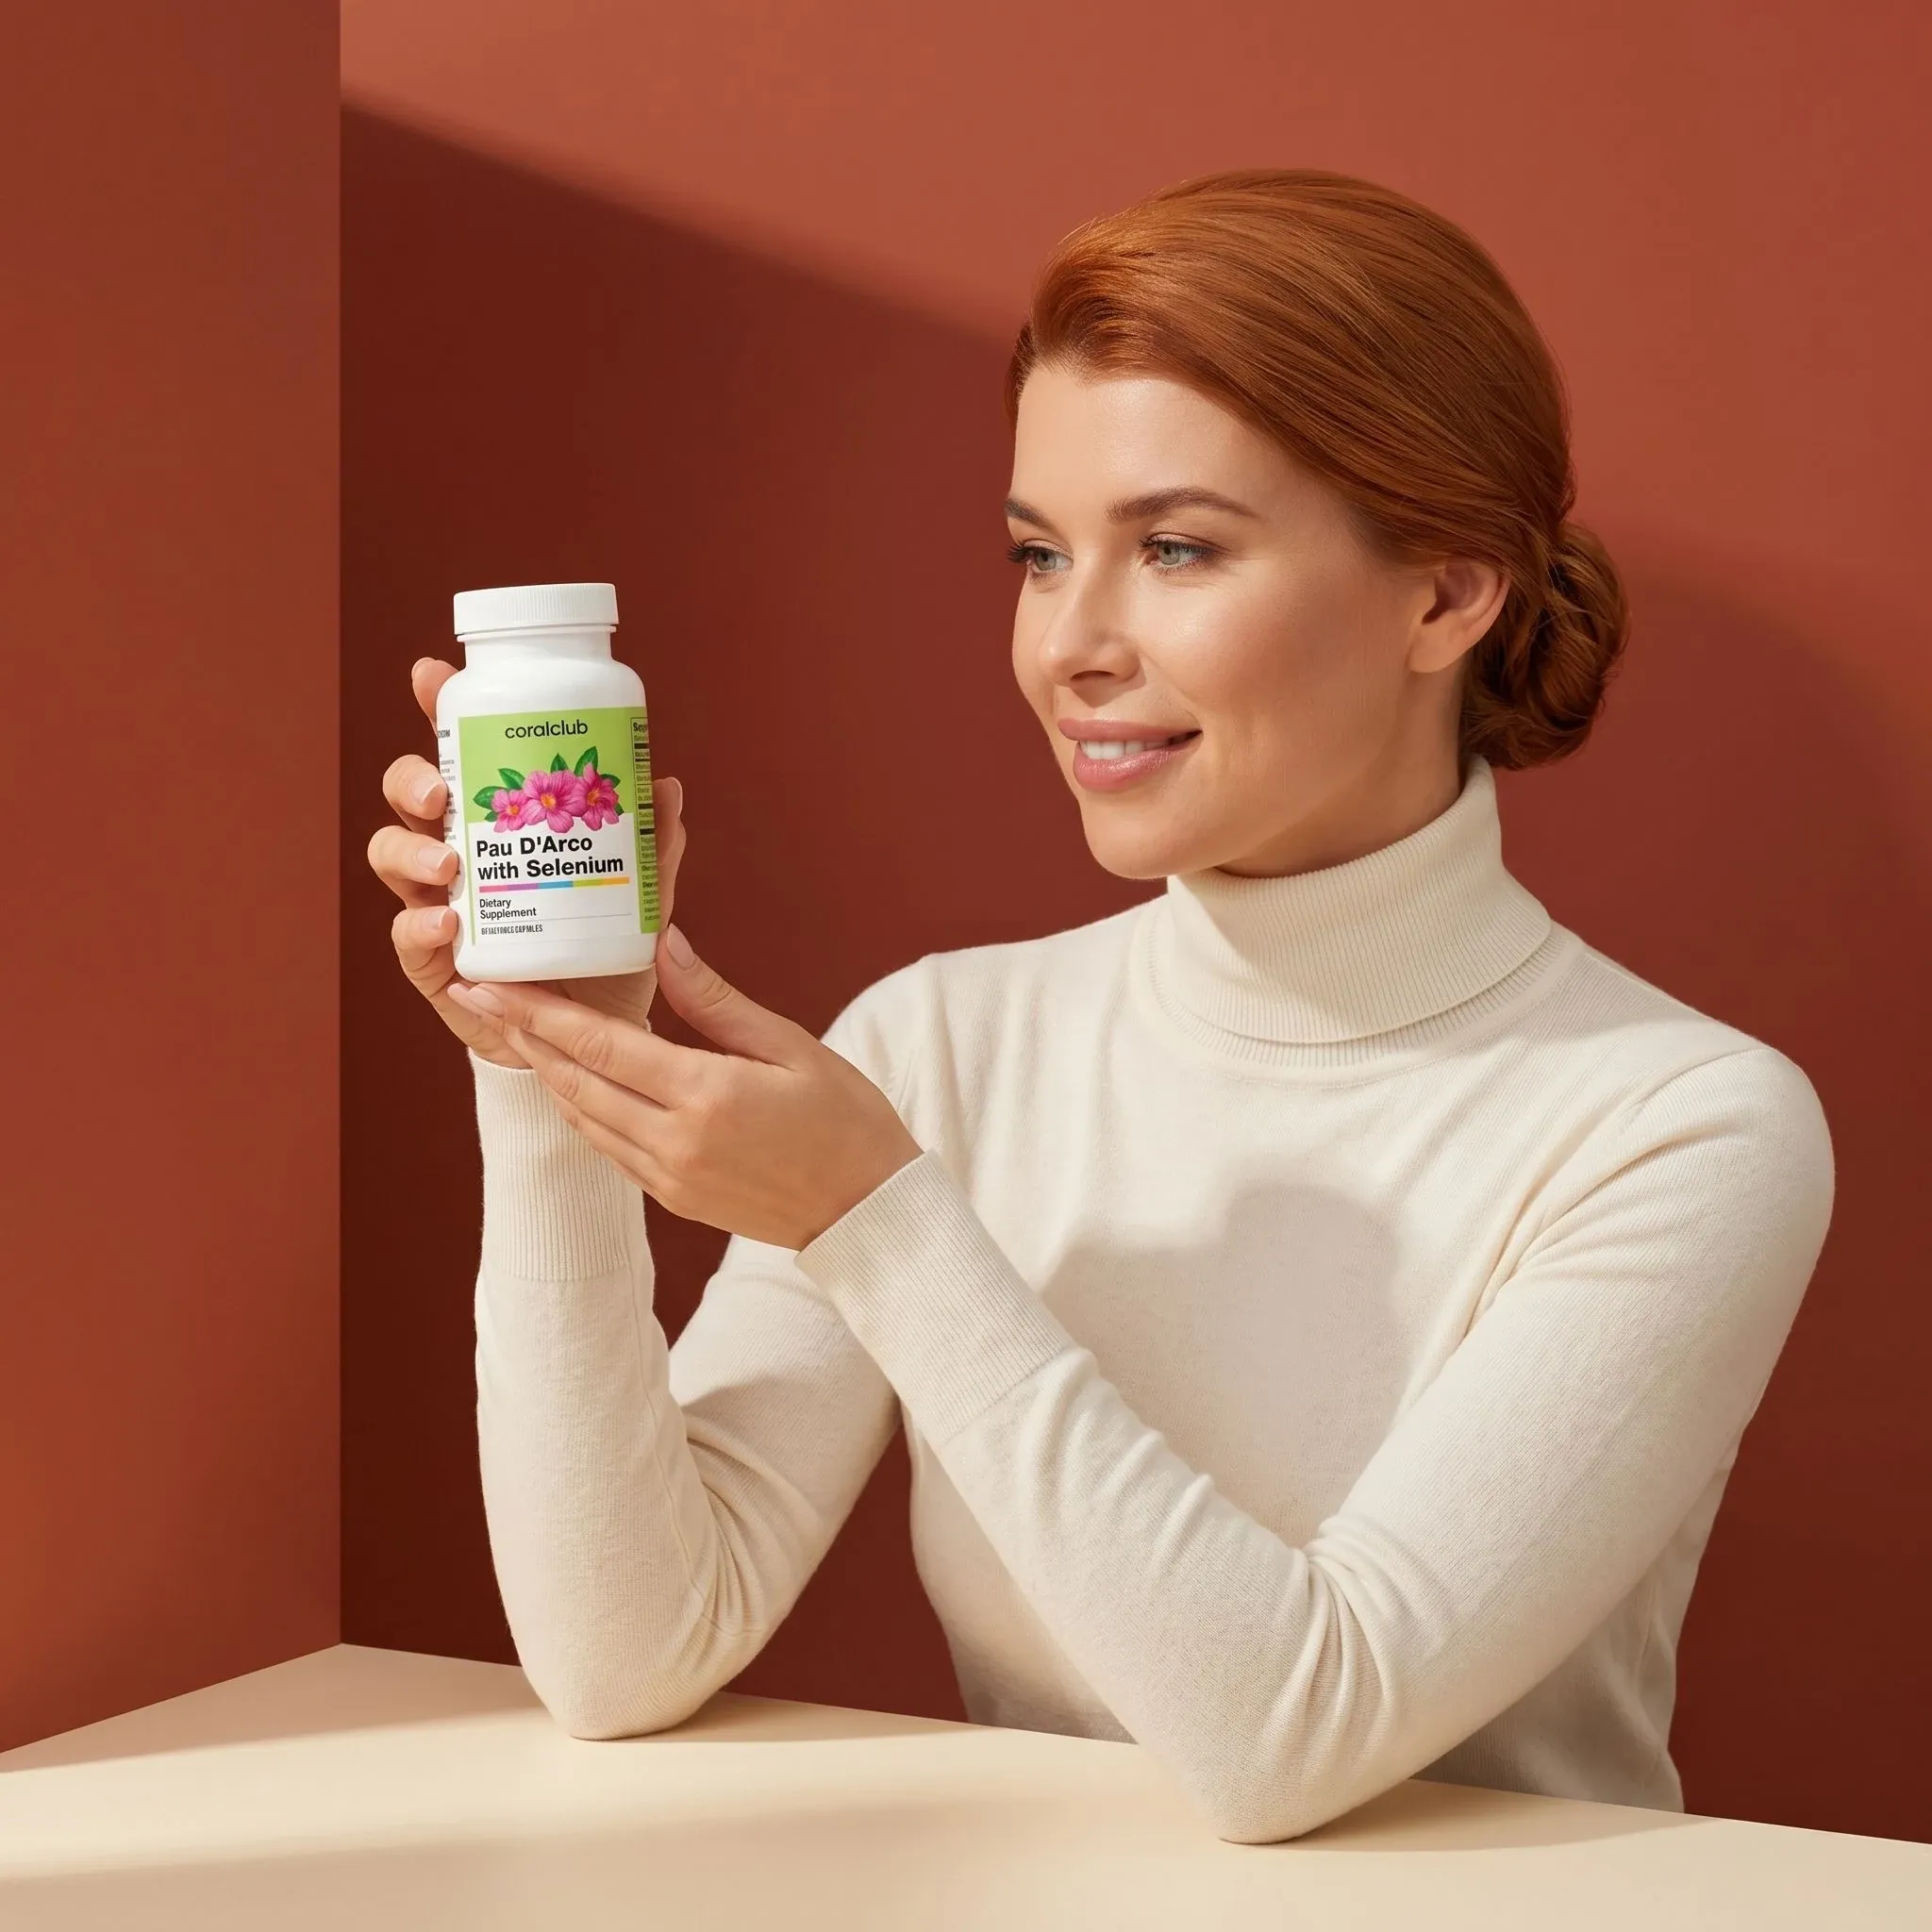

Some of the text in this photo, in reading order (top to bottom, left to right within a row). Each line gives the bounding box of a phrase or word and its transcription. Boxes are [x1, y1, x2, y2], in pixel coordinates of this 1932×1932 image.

[505, 719, 589, 739] coralclub
[476, 835, 592, 858] Pau D'Arco
[477, 857, 624, 880] with Selenium
[479, 898, 511, 908] Dietary
[480, 908, 537, 921] Supplement
